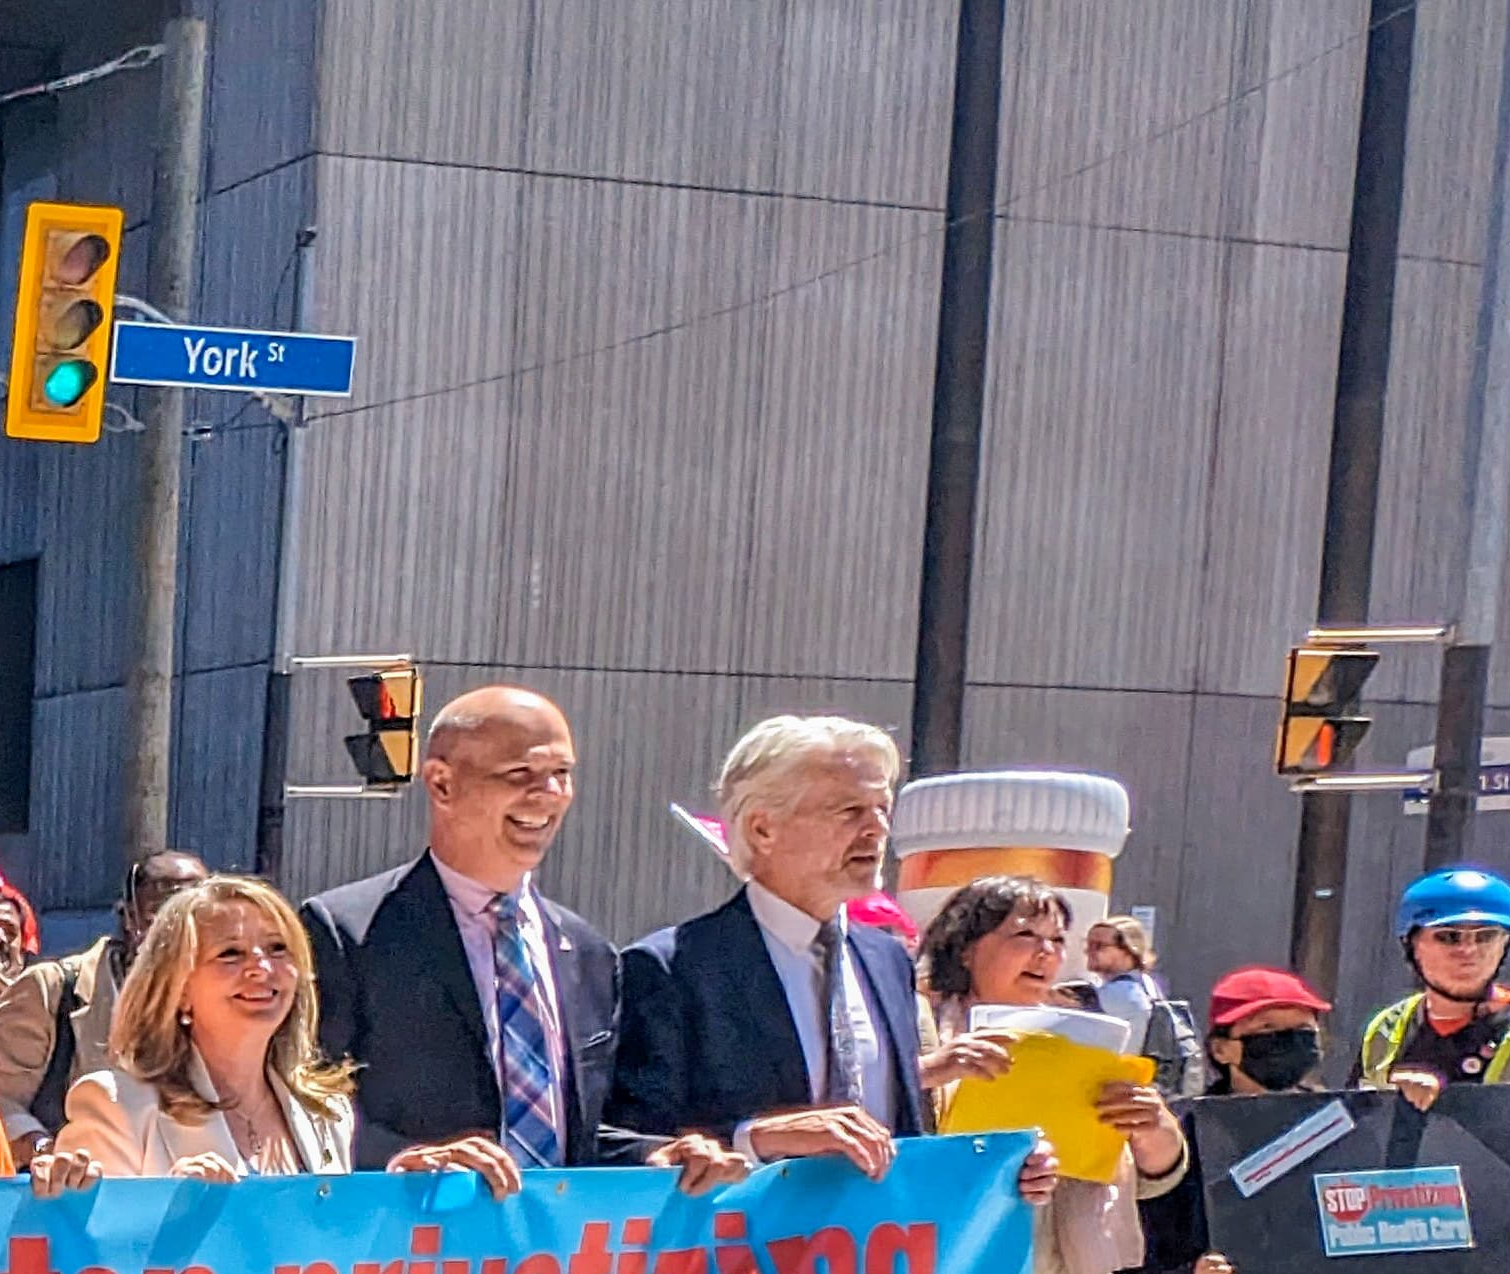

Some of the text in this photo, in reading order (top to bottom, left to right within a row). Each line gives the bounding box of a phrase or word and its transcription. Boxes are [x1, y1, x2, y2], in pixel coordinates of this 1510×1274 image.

[183, 336, 286, 379] York St
[1324, 1186, 1367, 1213] STOP
